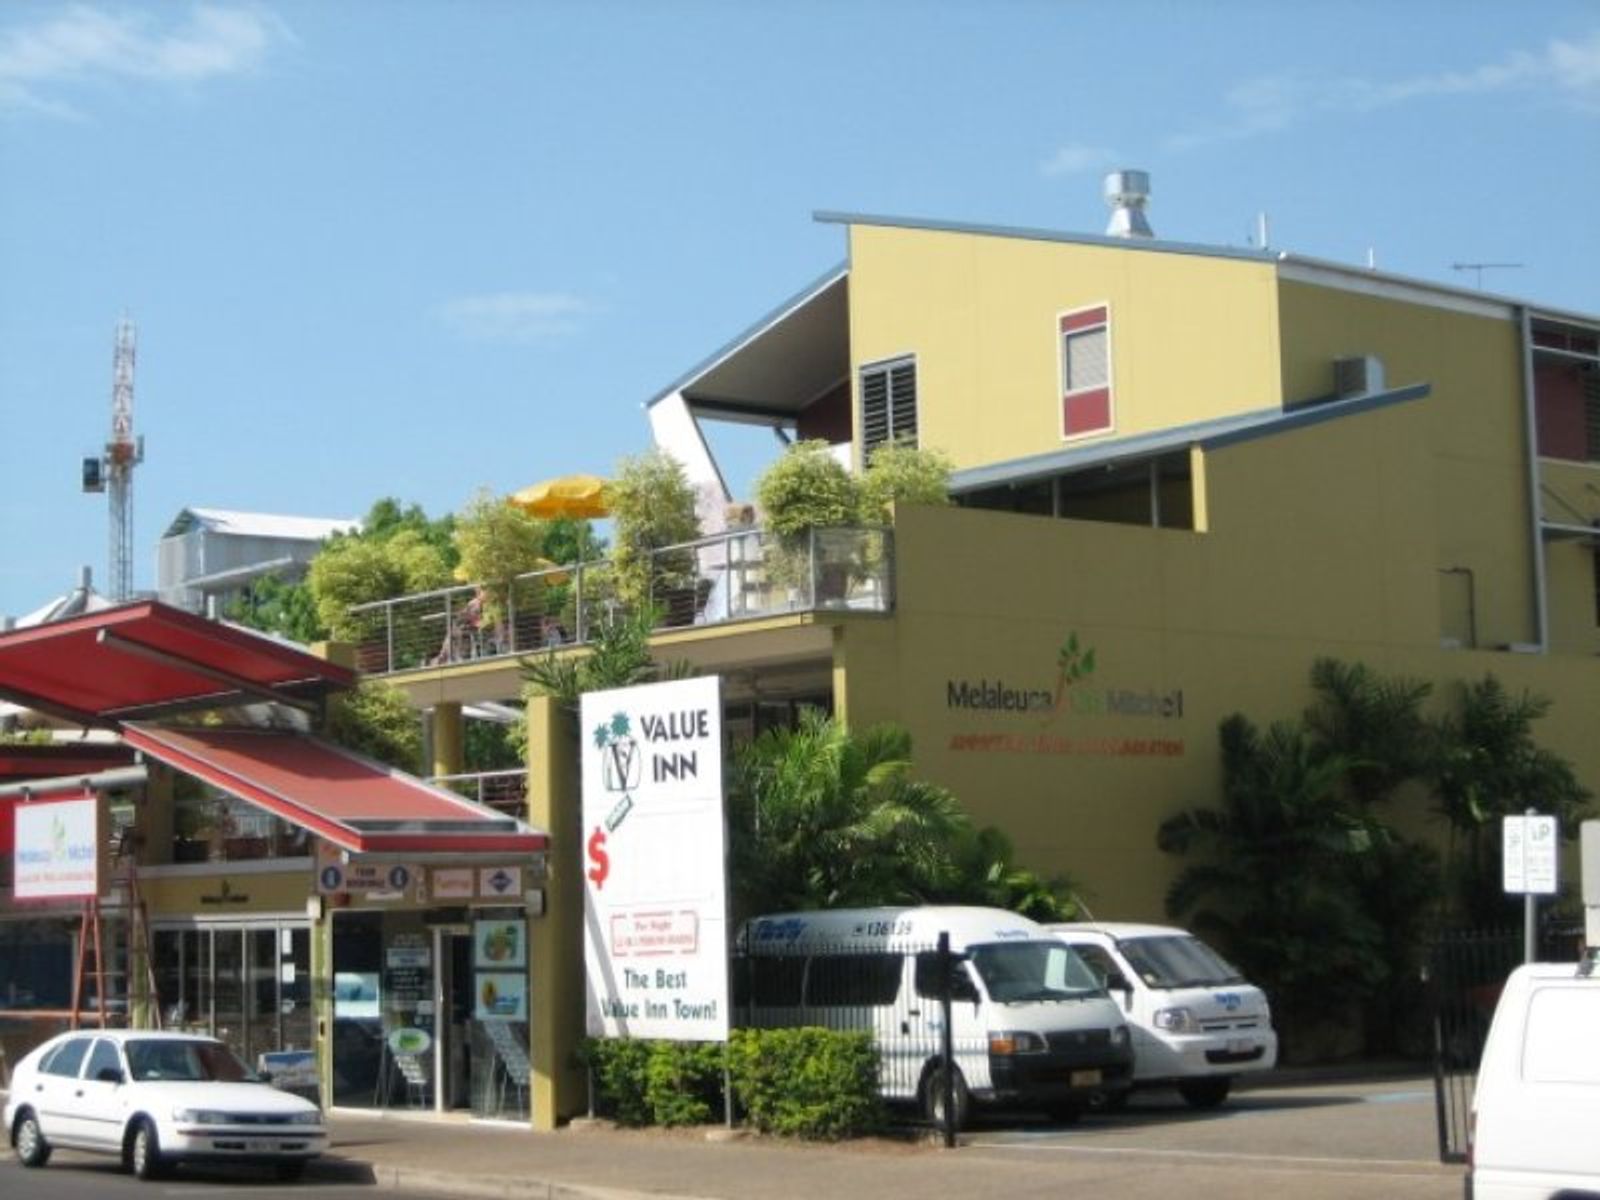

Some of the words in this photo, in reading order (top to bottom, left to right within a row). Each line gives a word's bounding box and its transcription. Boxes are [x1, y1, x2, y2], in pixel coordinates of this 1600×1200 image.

[947, 679, 1052, 712] Melaleuca
[640, 709, 709, 742] VALUE
[653, 750, 698, 782] INN
[588, 826, 609, 890] $
[624, 968, 649, 989] The
[656, 968, 688, 989] Best
[602, 997, 640, 1018] Value
[645, 998, 668, 1019] Inn
[673, 998, 717, 1021] Town!
